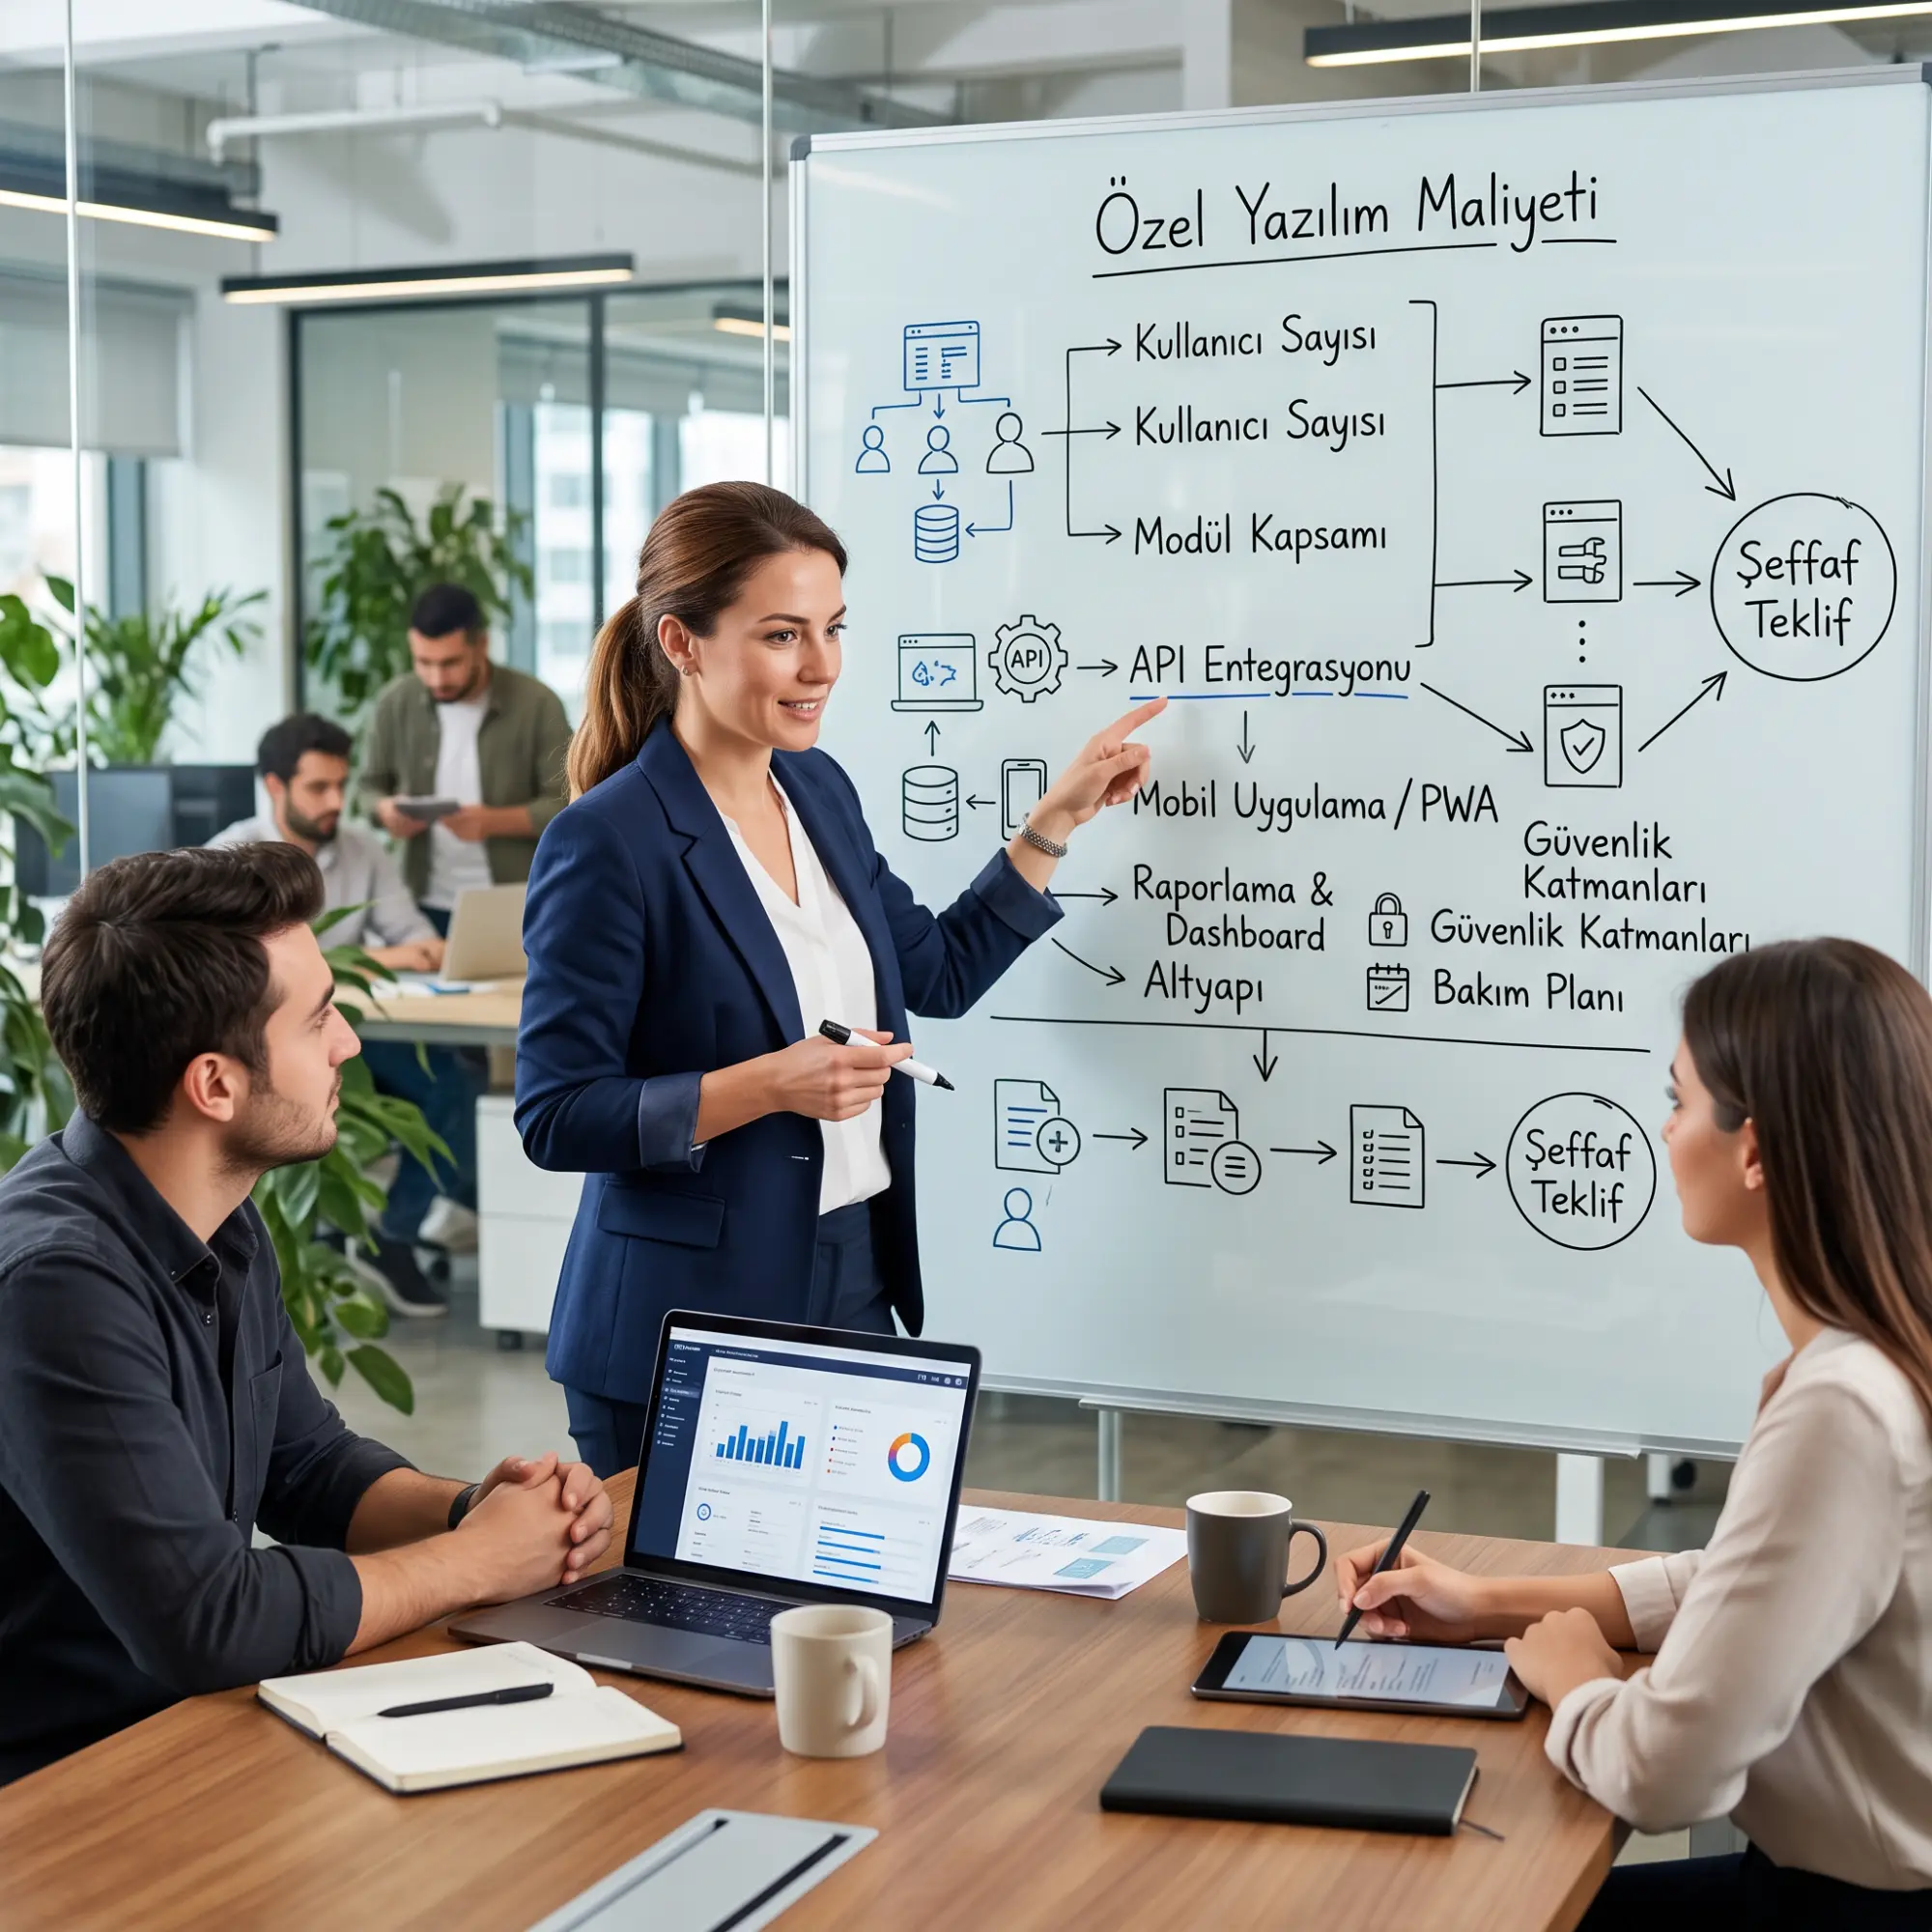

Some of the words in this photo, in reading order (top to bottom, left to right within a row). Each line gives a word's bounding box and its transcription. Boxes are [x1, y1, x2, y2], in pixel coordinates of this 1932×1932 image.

[1095, 175, 1204, 255] Özel
[1235, 182, 1388, 245] Yazılım
[1418, 169, 1598, 253] Maliyeti
[1136, 321, 1262, 362] Kullanıcı
[1281, 313, 1376, 367] Sayısı
[1136, 404, 1267, 446] Kullanıcı
[1286, 398, 1384, 453] Sayısı
[1134, 512, 1231, 555] Modül
[1252, 512, 1386, 565] Kapsamı
[1736, 538, 1862, 589] Şeffaf
[1744, 596, 1854, 647] Teklif
[1010, 648, 1043, 668] API
[1129, 644, 1184, 684] API
[1205, 644, 1411, 697] Entegrasyonu
[1133, 779, 1216, 818] Mobil
[1234, 781, 1386, 834] Uygulama
[1393, 777, 1413, 831] /
[1421, 783, 1499, 823] PWA
[1523, 820, 1673, 860] Güvenlik
[1133, 865, 1296, 910] Raporlama
[1310, 870, 1334, 907] &
[1524, 863, 1706, 903] Katmanları
[1166, 913, 1325, 952] Dashboard
[1431, 908, 1564, 948] Güvenlik
[1580, 917, 1750, 953] Katmanları
[1143, 959, 1263, 1016] Altyapı
[1434, 968, 1529, 1009] Bakım
[1547, 972, 1623, 1012] Planı
[1524, 1128, 1633, 1173] Şeffaf
[1530, 1179, 1625, 1224] Teklif
